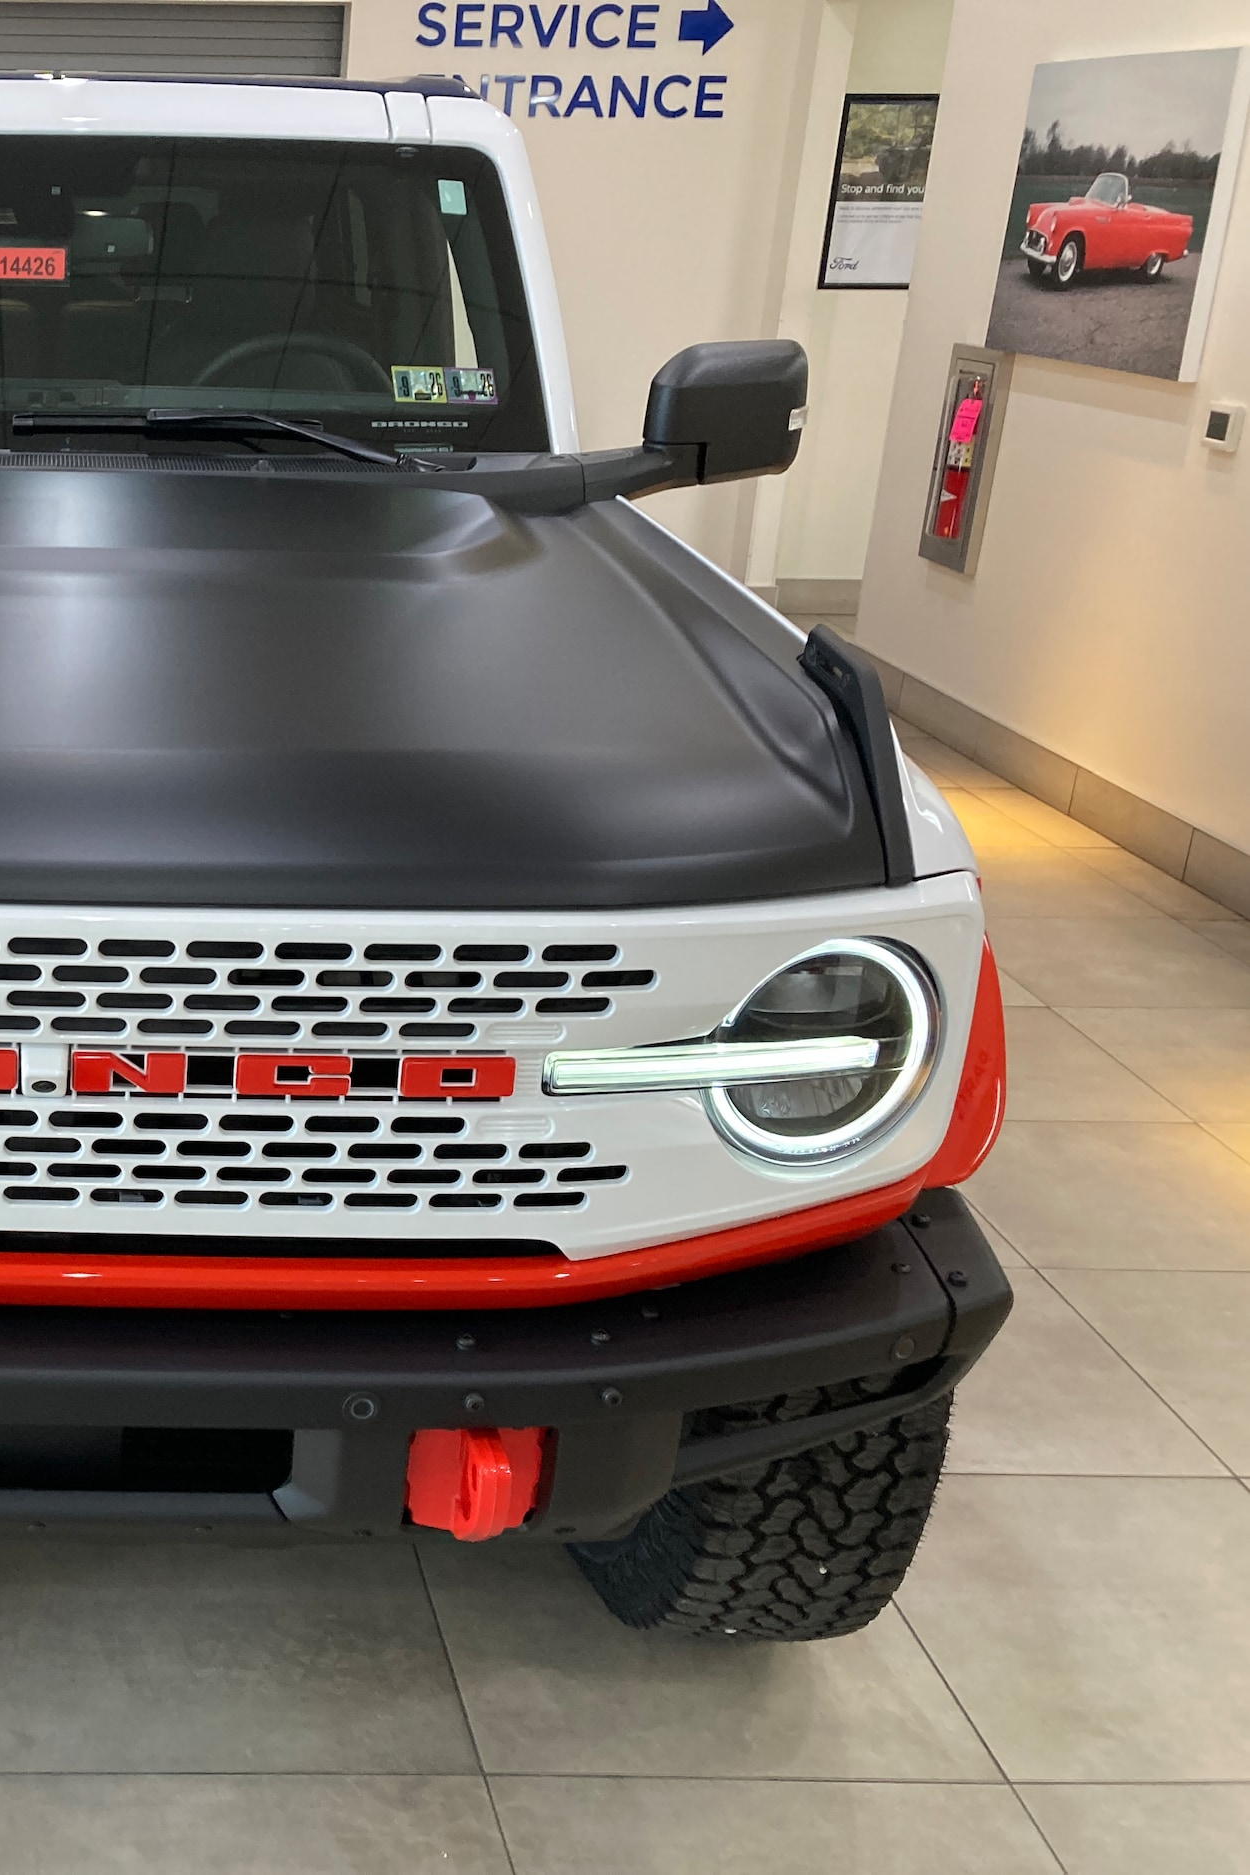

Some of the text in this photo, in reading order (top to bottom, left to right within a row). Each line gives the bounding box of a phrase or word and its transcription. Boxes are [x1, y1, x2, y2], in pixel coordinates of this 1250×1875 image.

[415, 2, 660, 48] SERVICE
[841, 183, 863, 195] Stop
[865, 183, 884, 194] and
[886, 183, 905, 194] find
[829, 257, 859, 270] Ford
